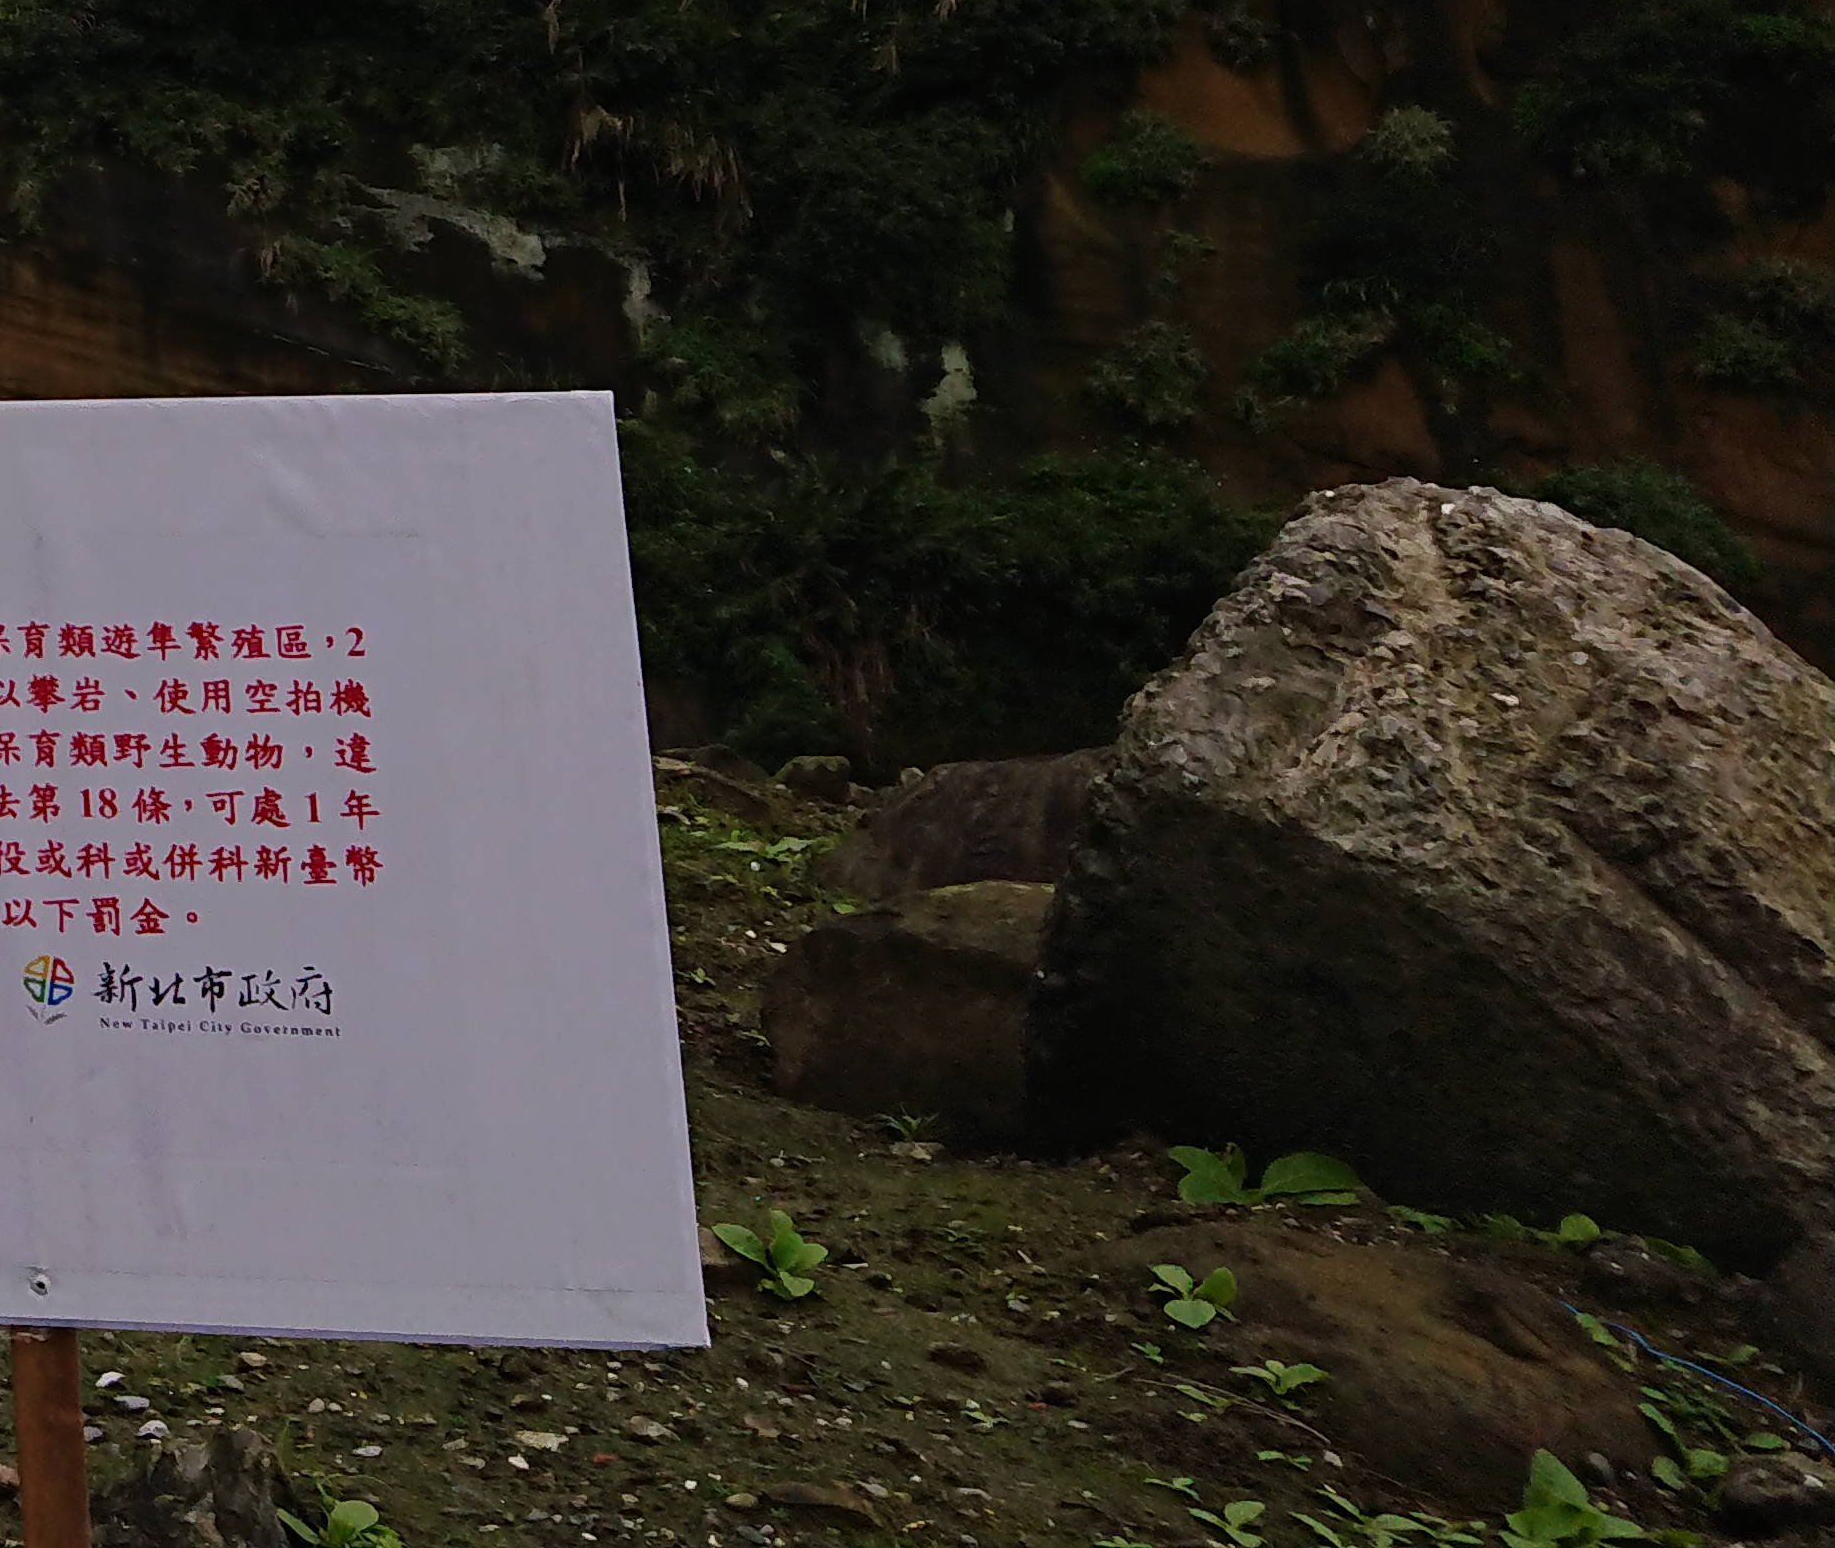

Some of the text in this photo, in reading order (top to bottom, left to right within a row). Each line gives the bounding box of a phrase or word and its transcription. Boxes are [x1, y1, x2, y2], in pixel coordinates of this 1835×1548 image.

[91, 961, 334, 1016] 新北市政府
[99, 1017, 342, 1038] New Taipei City Government
